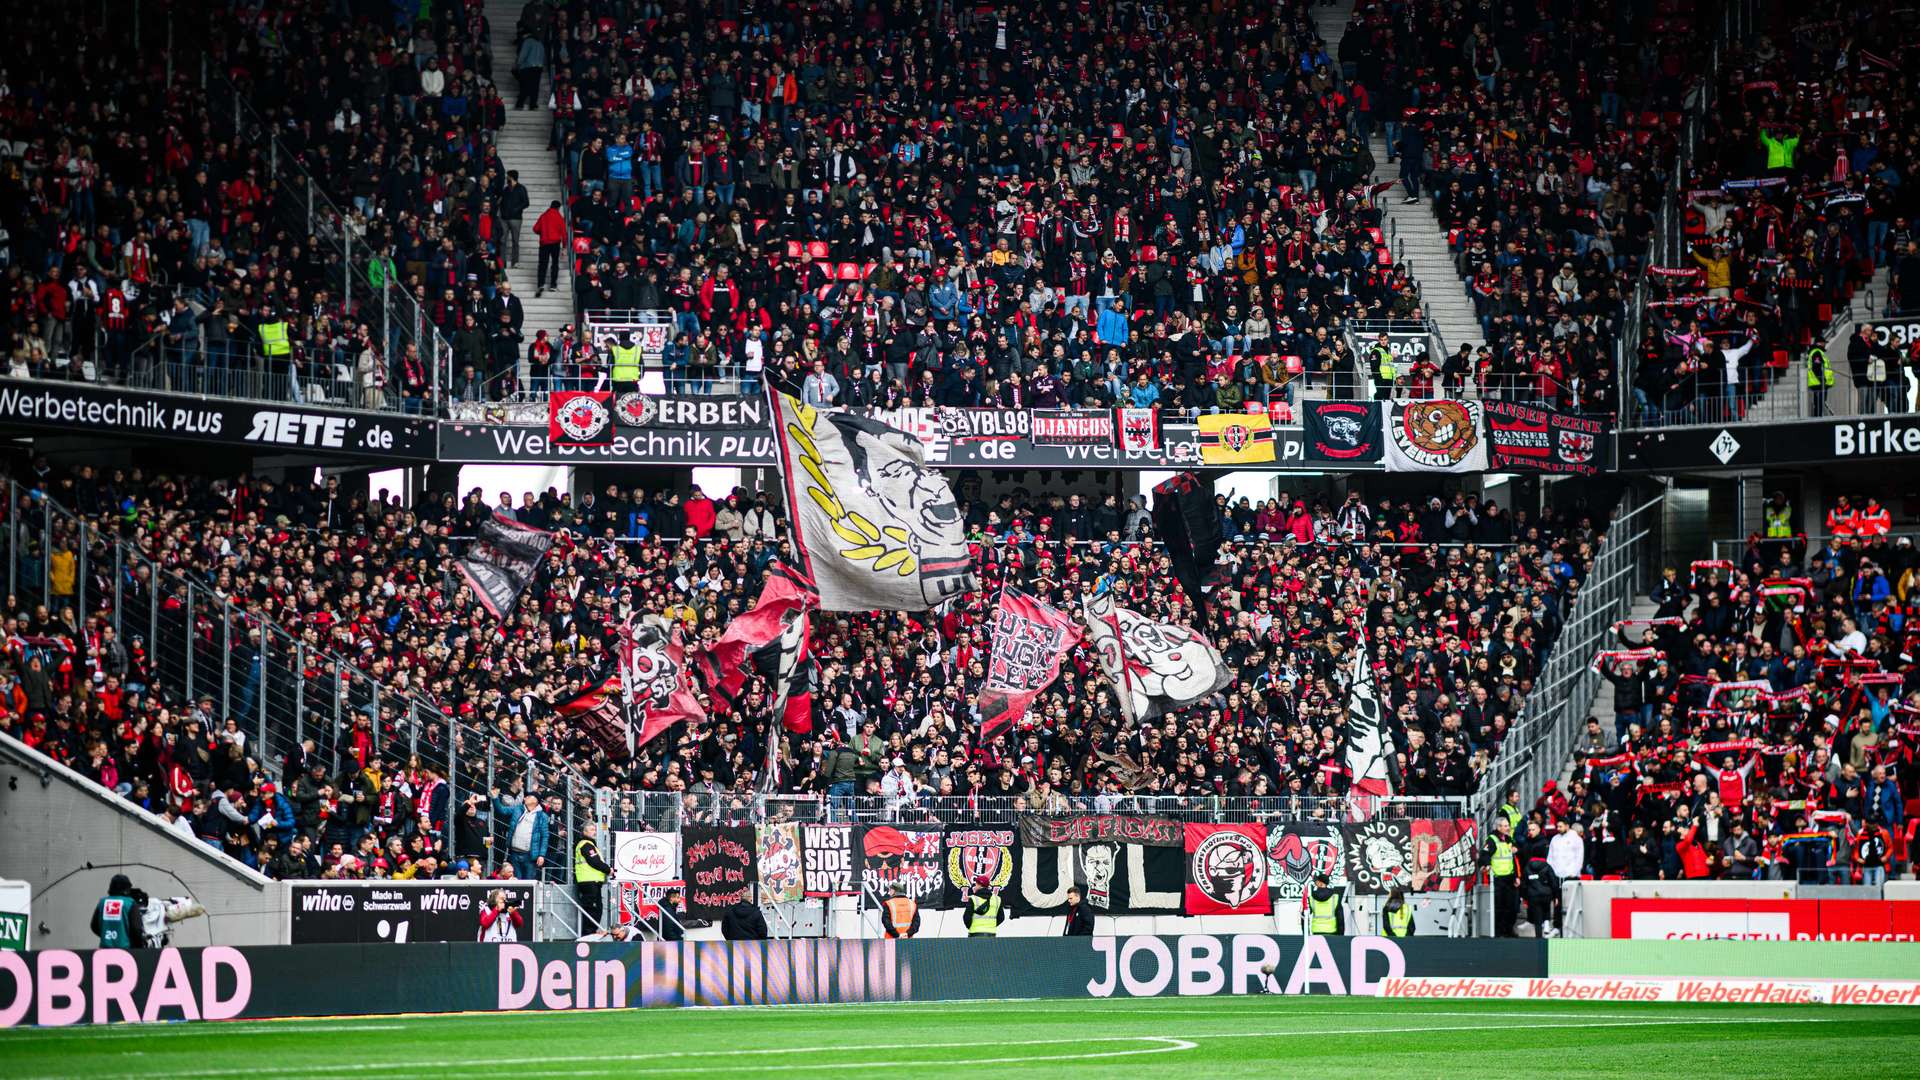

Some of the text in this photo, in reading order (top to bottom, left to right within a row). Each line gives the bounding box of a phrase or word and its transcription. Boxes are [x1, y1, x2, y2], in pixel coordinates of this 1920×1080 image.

[0, 388, 166, 429] Werbetechnik
[172, 409, 223, 434] PLUS
[658, 399, 760, 425] ERBEN
[969, 410, 1029, 435] YBL98
[1034, 417, 1110, 437] DJANGOS
[1493, 429, 1549, 441] GANSER
[719, 437, 777, 458] PLU
[804, 827, 852, 849] WEST
[946, 831, 1014, 847] JUGEND
[804, 849, 852, 870] SIDE
[805, 871, 853, 891] BOYZ
[303, 890, 342, 911] wiha
[372, 890, 403, 900] Made im
[420, 888, 458, 911] wiha
[363, 901, 411, 911] Schwarzwald
[104, 930, 118, 940] 20
[498, 942, 627, 1010] Dein
[1086, 933, 1406, 998] JOBRAD
[1384, 978, 1513, 998] WeberHaus
[1527, 979, 1663, 1001] WeberHaus
[1675, 981, 1813, 1004] WeberHaus
